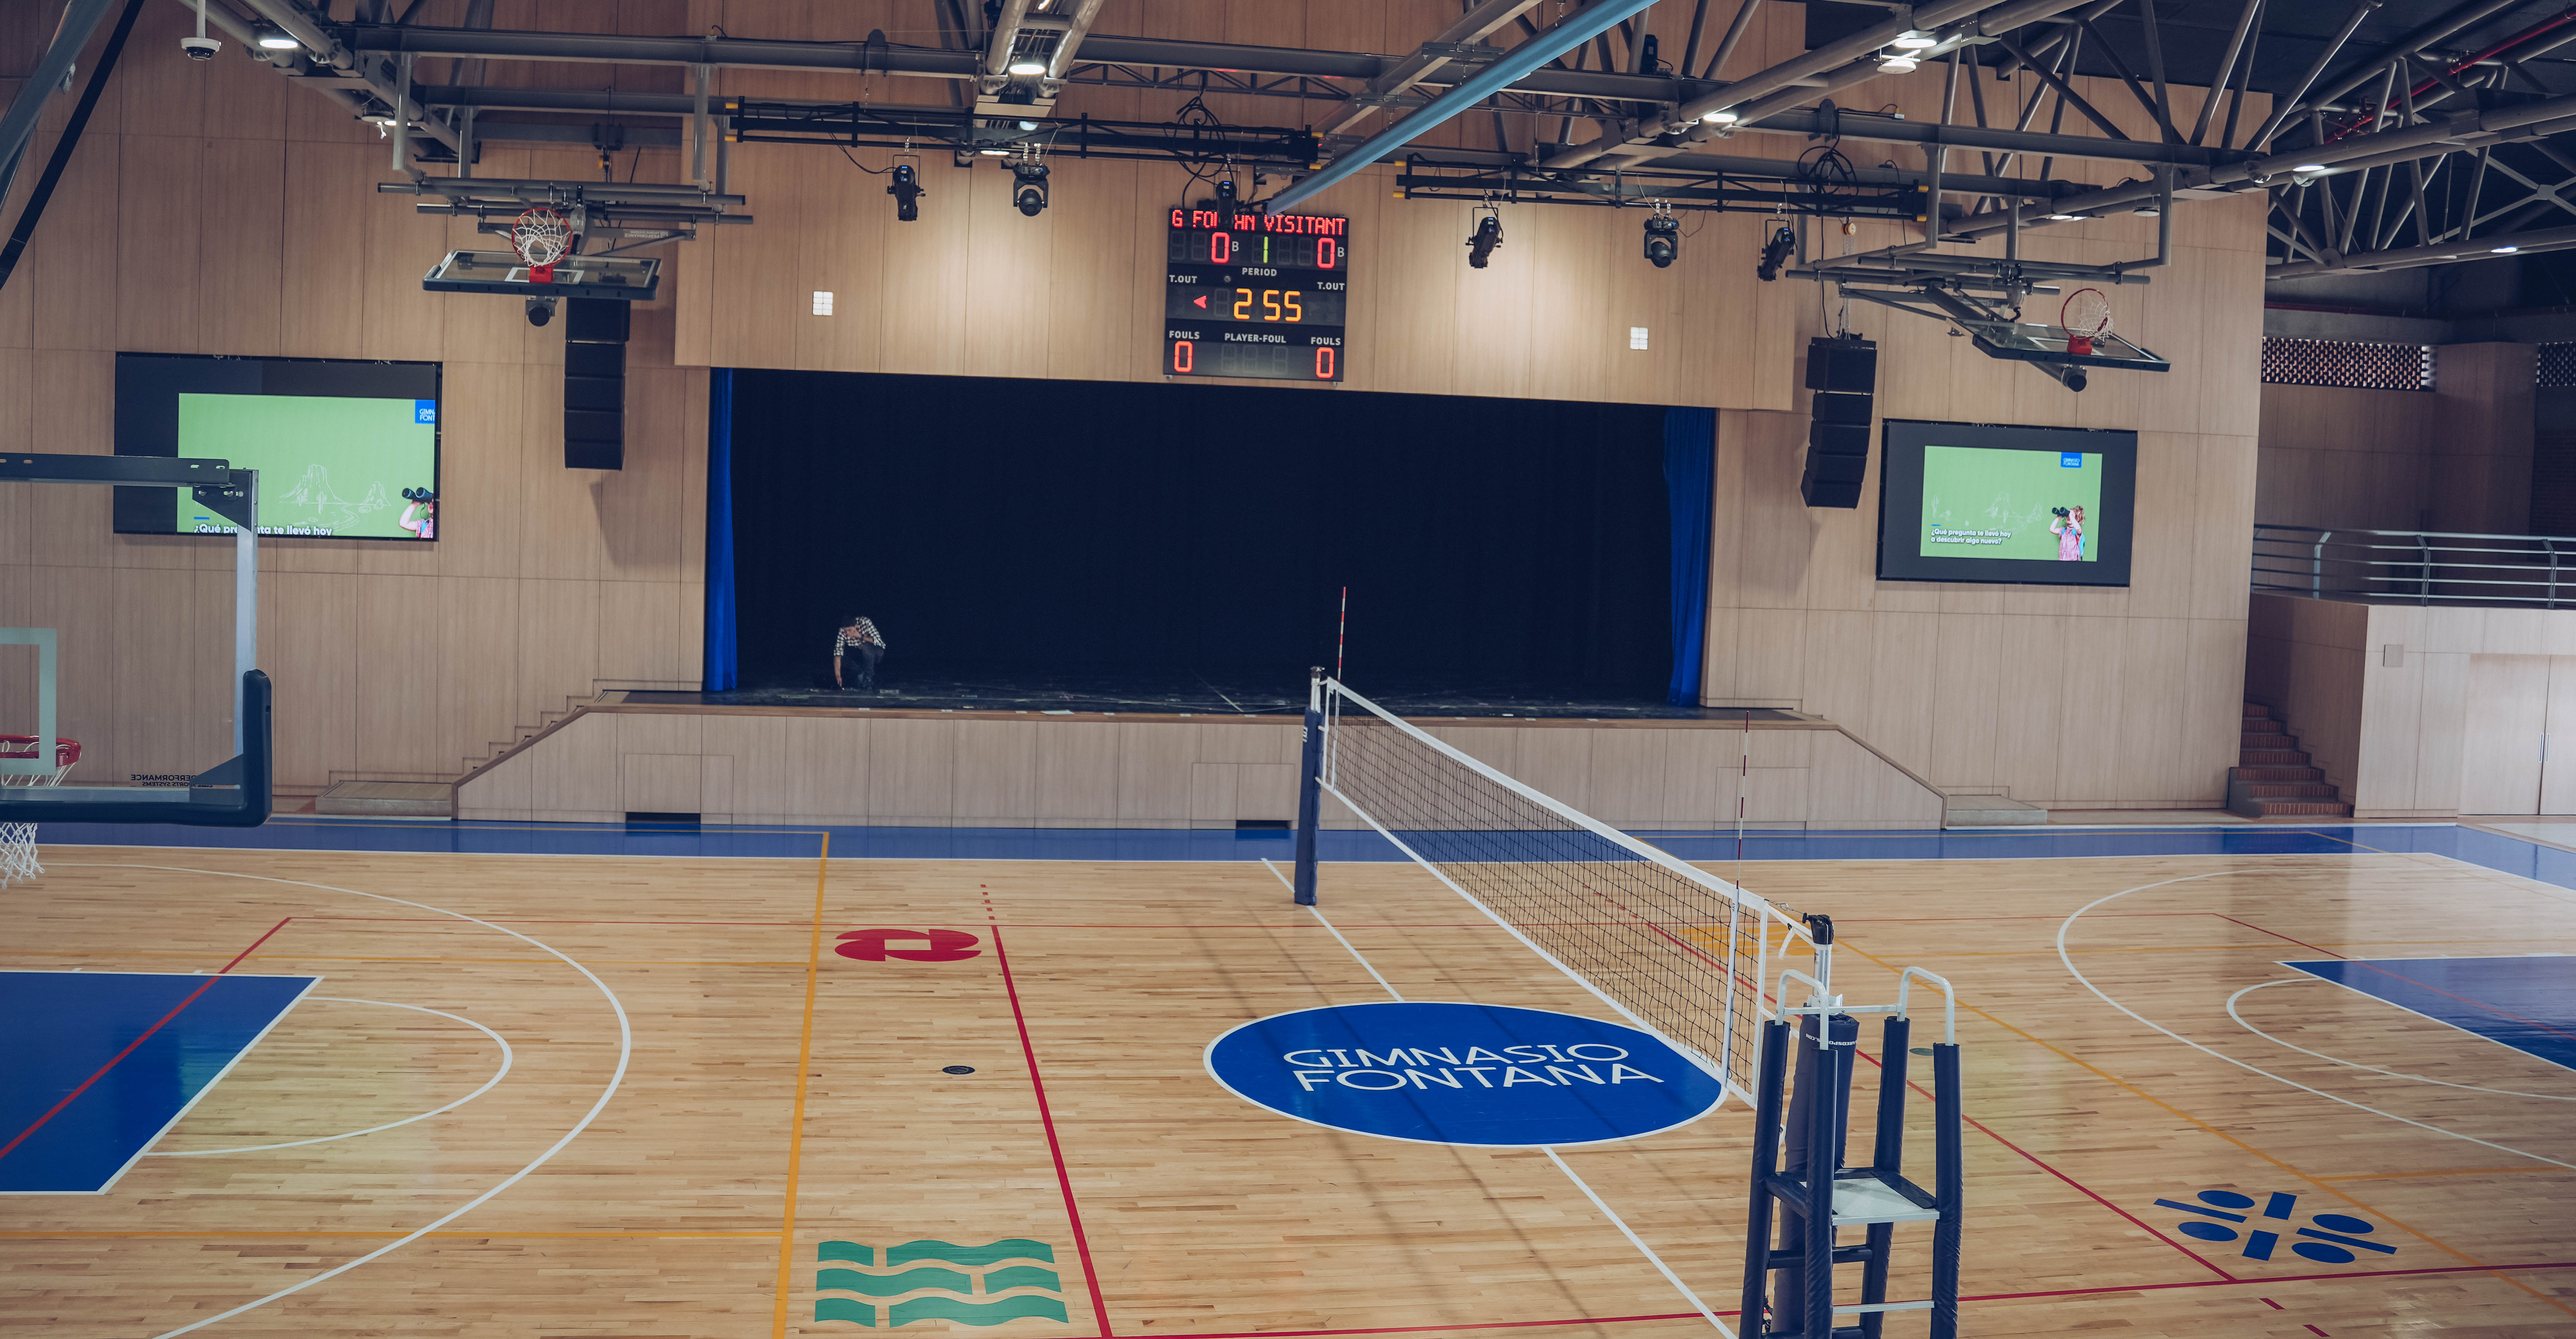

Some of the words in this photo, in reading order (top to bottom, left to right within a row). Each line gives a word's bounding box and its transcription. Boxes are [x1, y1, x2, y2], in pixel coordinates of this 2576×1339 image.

[1172, 209, 1183, 228] G
[1264, 214, 1346, 235] VISITANT
[1211, 232, 1230, 263] 0
[1232, 241, 1239, 252] B
[1263, 236, 1268, 263] 1
[1317, 237, 1335, 268] 0
[1337, 247, 1345, 257] B
[1169, 275, 1197, 283] T.OUT
[1242, 268, 1277, 276] PERIOD
[1317, 282, 1345, 291] T.OUT
[1169, 330, 1200, 340] FOULS
[1224, 333, 1286, 343] PLAYER-FOUL
[1310, 336, 1341, 346] FOULS
[1174, 341, 1193, 372] 0
[1316, 347, 1334, 378] 0
[273, 525, 284, 535] te
[287, 525, 311, 535] llevó
[1283, 1044, 1629, 1068] GIMNASIO
[1292, 1063, 1665, 1091] FONTANA
